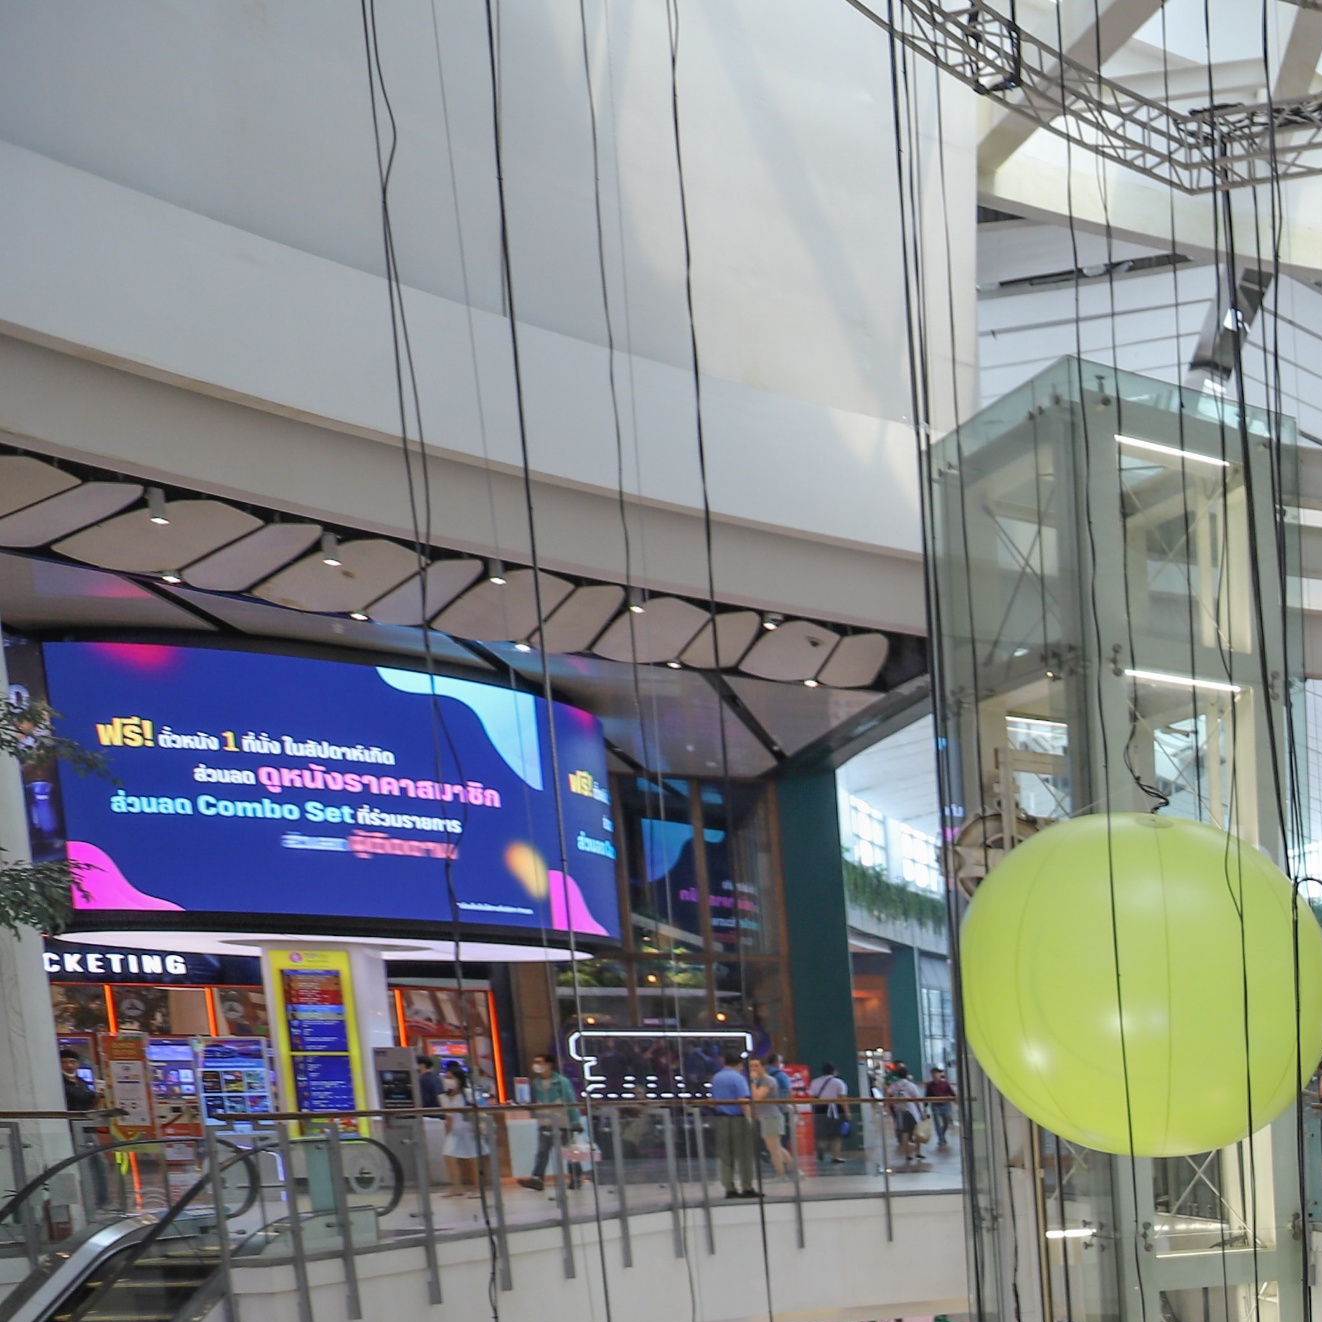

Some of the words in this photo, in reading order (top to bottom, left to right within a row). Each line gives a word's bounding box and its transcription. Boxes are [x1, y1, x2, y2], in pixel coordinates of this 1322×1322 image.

[96, 716, 155, 747] ฟรี!
[222, 731, 241, 752] 1
[193, 763, 257, 785] ส่วนลด
[257, 763, 502, 809] ดูหนังราคาสมาชิก
[110, 789, 194, 815] ส่วนลด
[197, 794, 299, 820] Combo
[304, 800, 356, 824] Set
